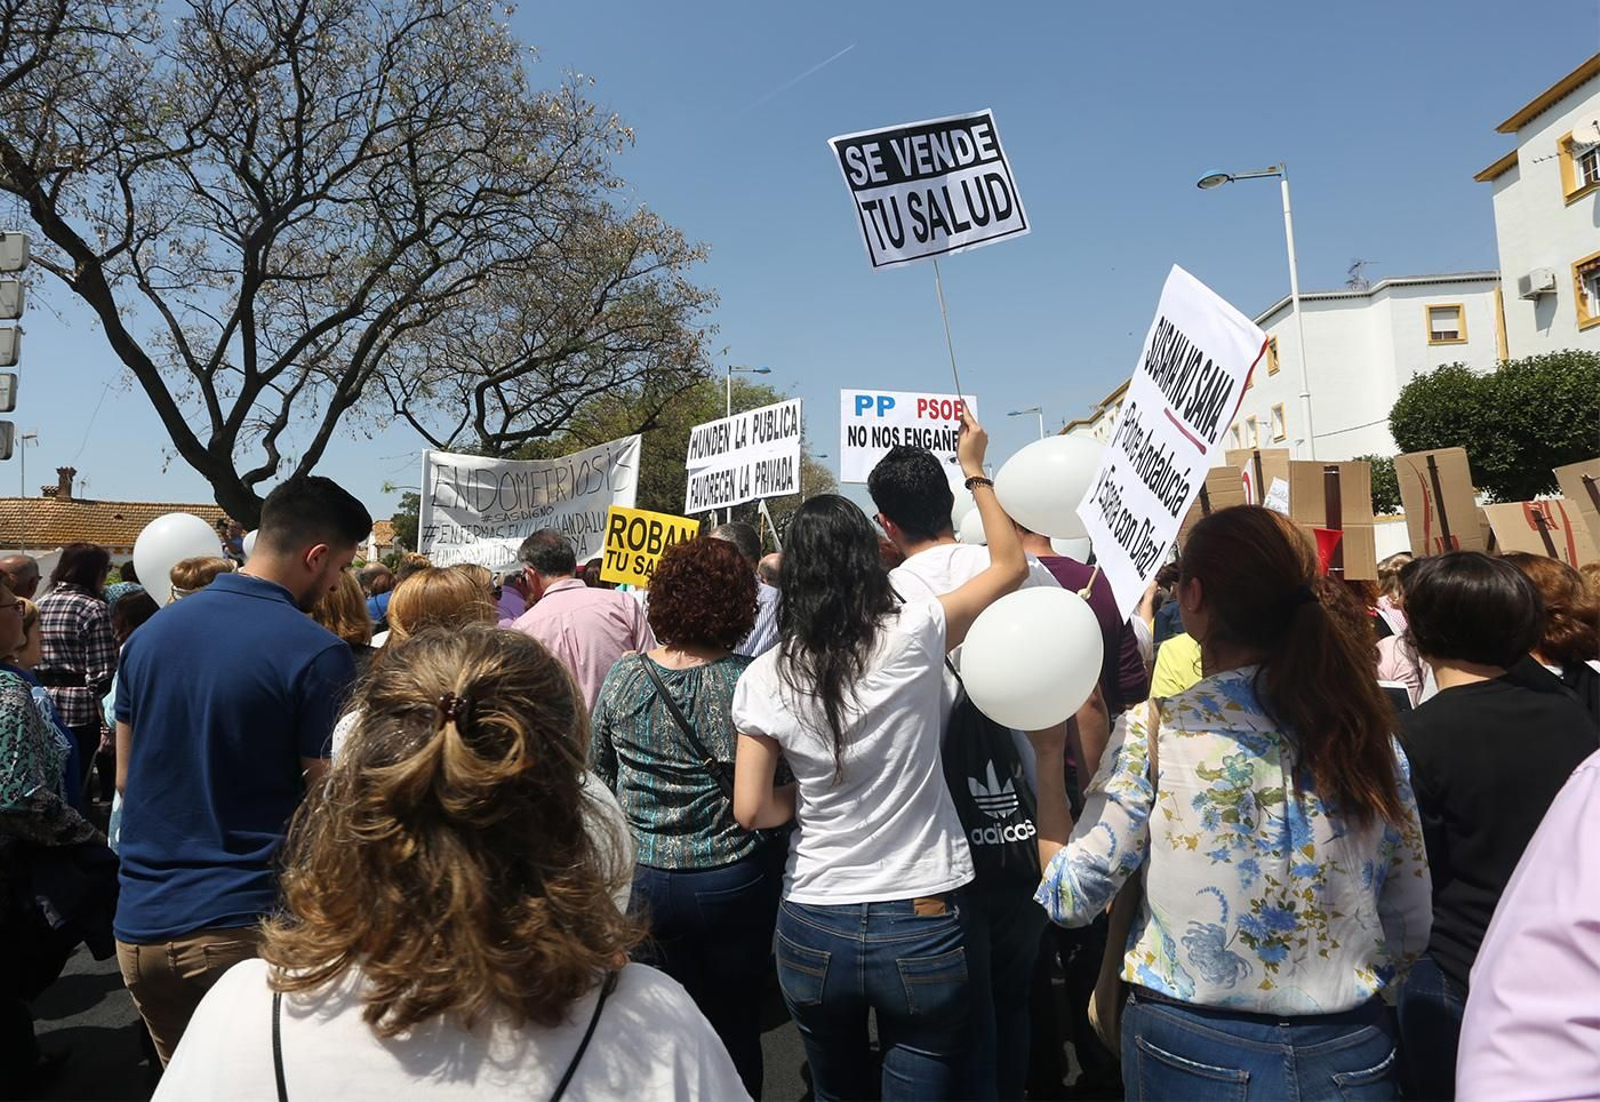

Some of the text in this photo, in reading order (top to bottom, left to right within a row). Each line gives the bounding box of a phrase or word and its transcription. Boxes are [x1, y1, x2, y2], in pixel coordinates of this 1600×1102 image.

[845, 123, 998, 186] SE VENDE
[861, 172, 1012, 250] TU SALUD
[855, 394, 963, 421] PP PSOE
[1144, 316, 1234, 445] SUSANA NO SANA.
[690, 404, 798, 460] HUNDEN LA PUBLICA
[847, 424, 959, 452] NO NOS ENGAÑE
[689, 455, 794, 510] FAVORECEN LA PRIVADA
[1132, 428, 1192, 518] Andalucía
[606, 550, 629, 571] TU
[1114, 508, 1138, 551] con
[1129, 517, 1166, 581] Díaz!
[971, 819, 1036, 845] adidas
